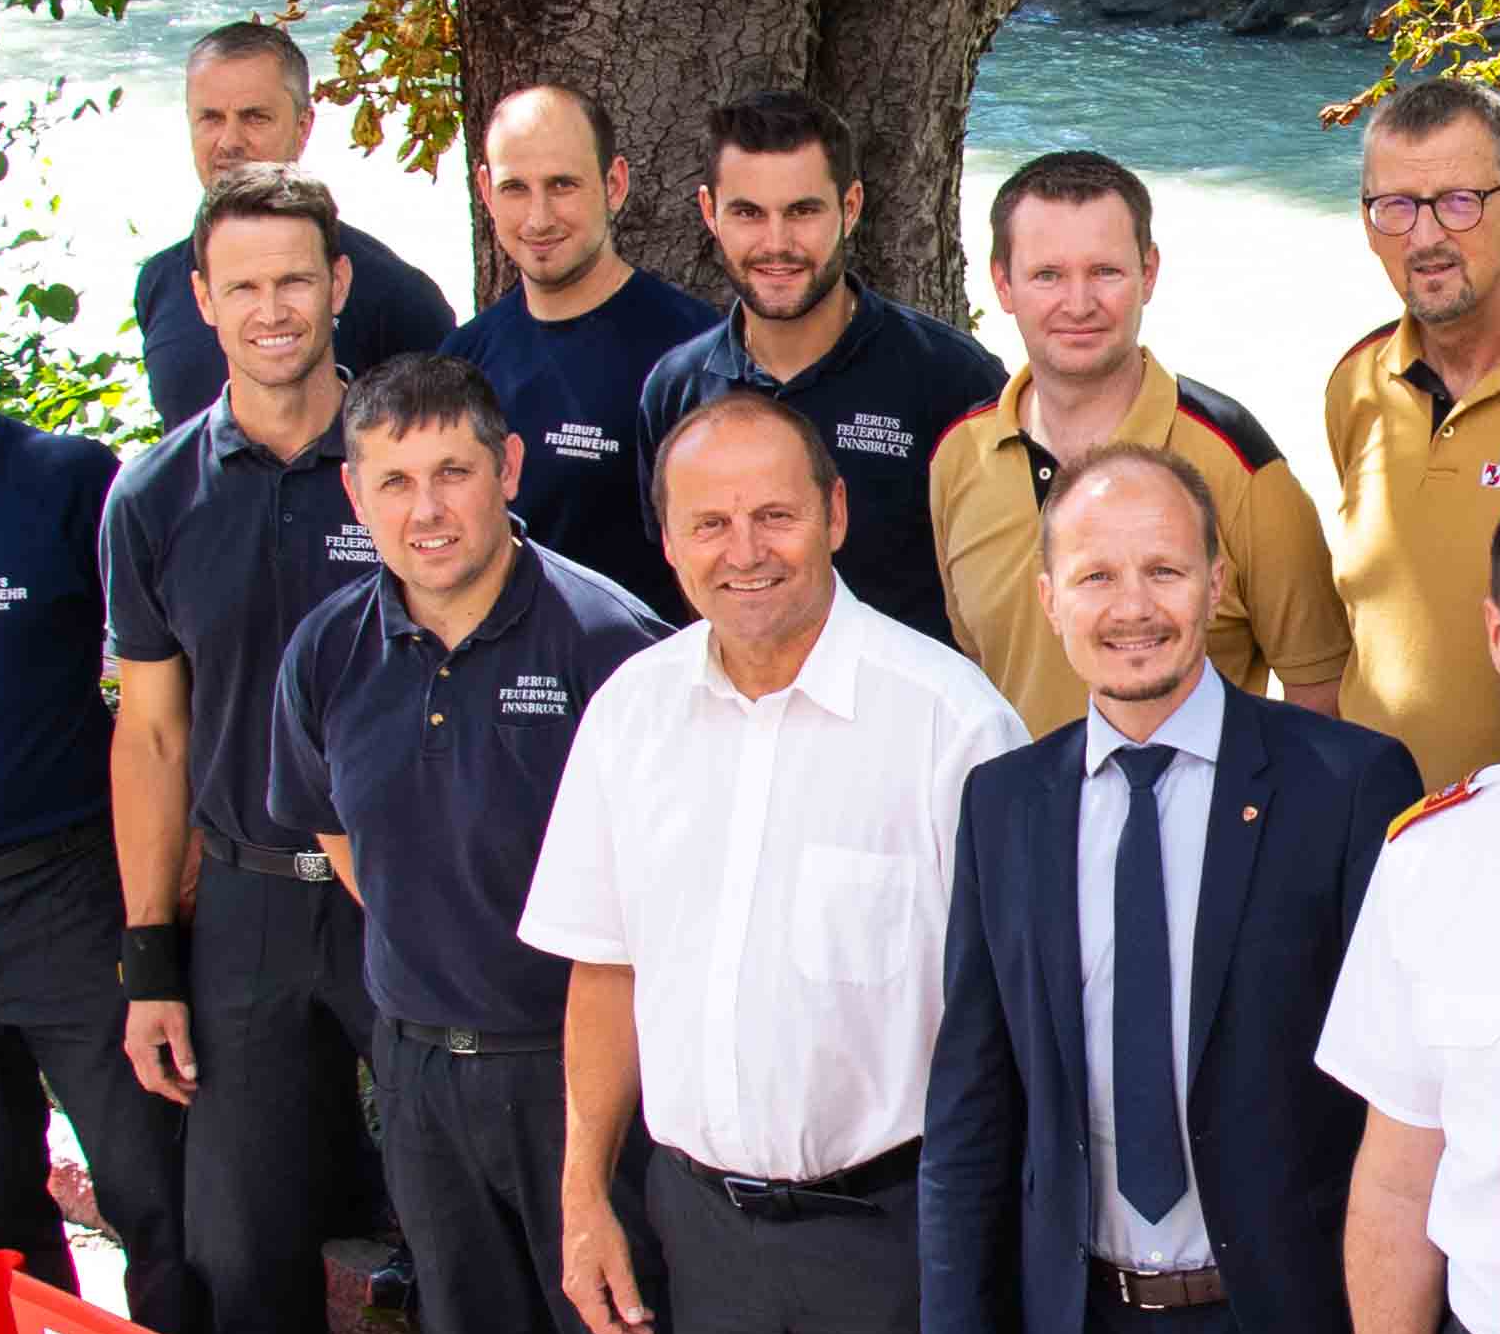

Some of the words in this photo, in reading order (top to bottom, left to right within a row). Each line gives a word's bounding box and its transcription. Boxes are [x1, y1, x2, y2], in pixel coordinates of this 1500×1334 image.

[853, 413, 901, 430] BERUFS
[561, 422, 603, 437] BERUFS
[836, 424, 914, 445] FEUERWEHR
[544, 432, 619, 453] FEUERWEHR
[837, 436, 909, 458] INNSBRUCK
[341, 524, 372, 536] BERU
[324, 535, 374, 550] FEUERW
[516, 676, 558, 688] BERUFS
[499, 688, 568, 703] FEUERWEHR
[501, 702, 566, 716] INNSBRUCK
